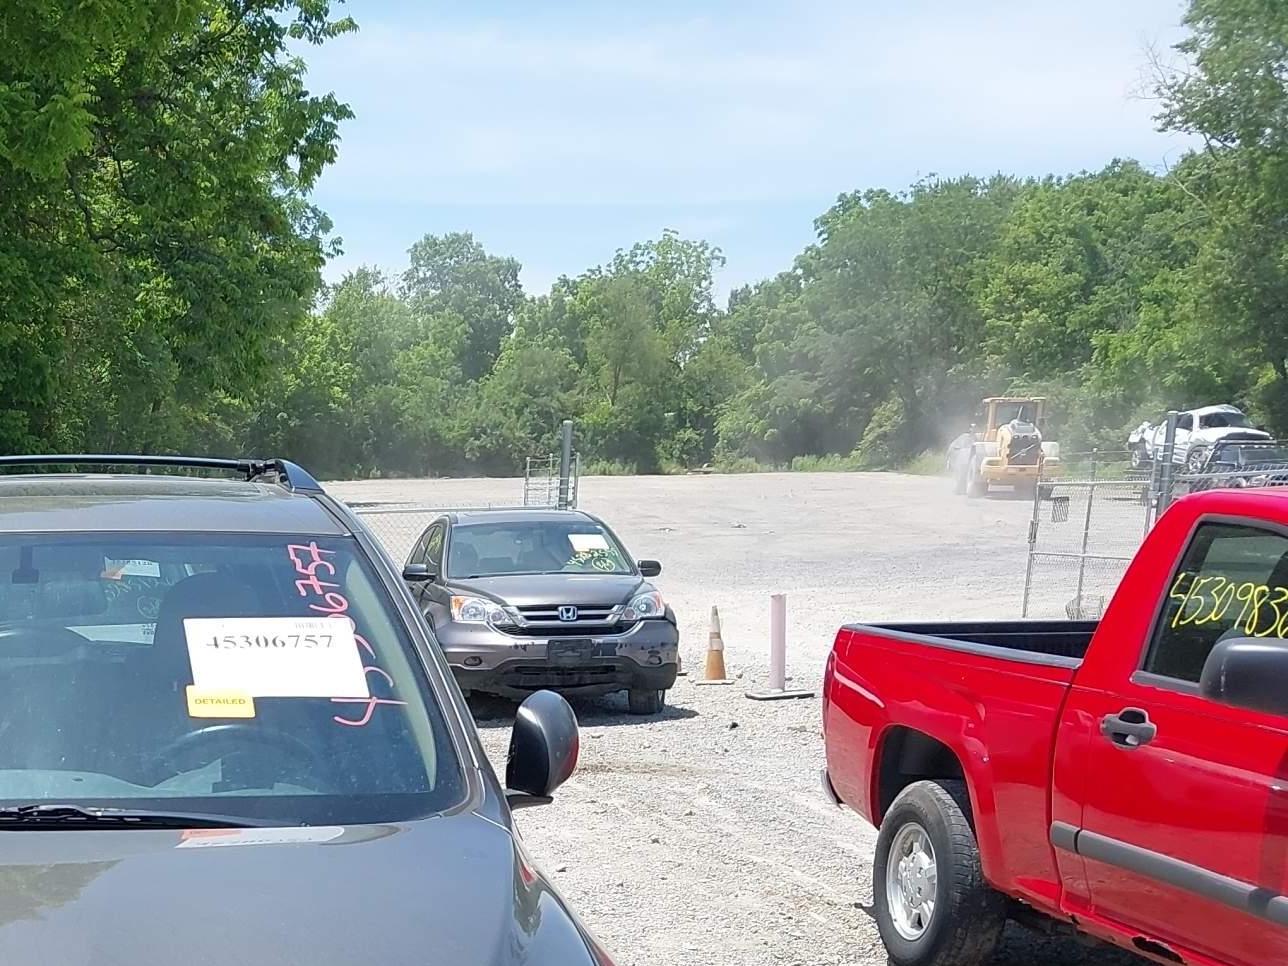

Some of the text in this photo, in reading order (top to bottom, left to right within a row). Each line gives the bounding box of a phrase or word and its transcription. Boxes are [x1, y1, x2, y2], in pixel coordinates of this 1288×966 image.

[206, 634, 334, 650] 45306757
[287, 541, 409, 727] 46757
[194, 697, 247, 706] DETAILED
